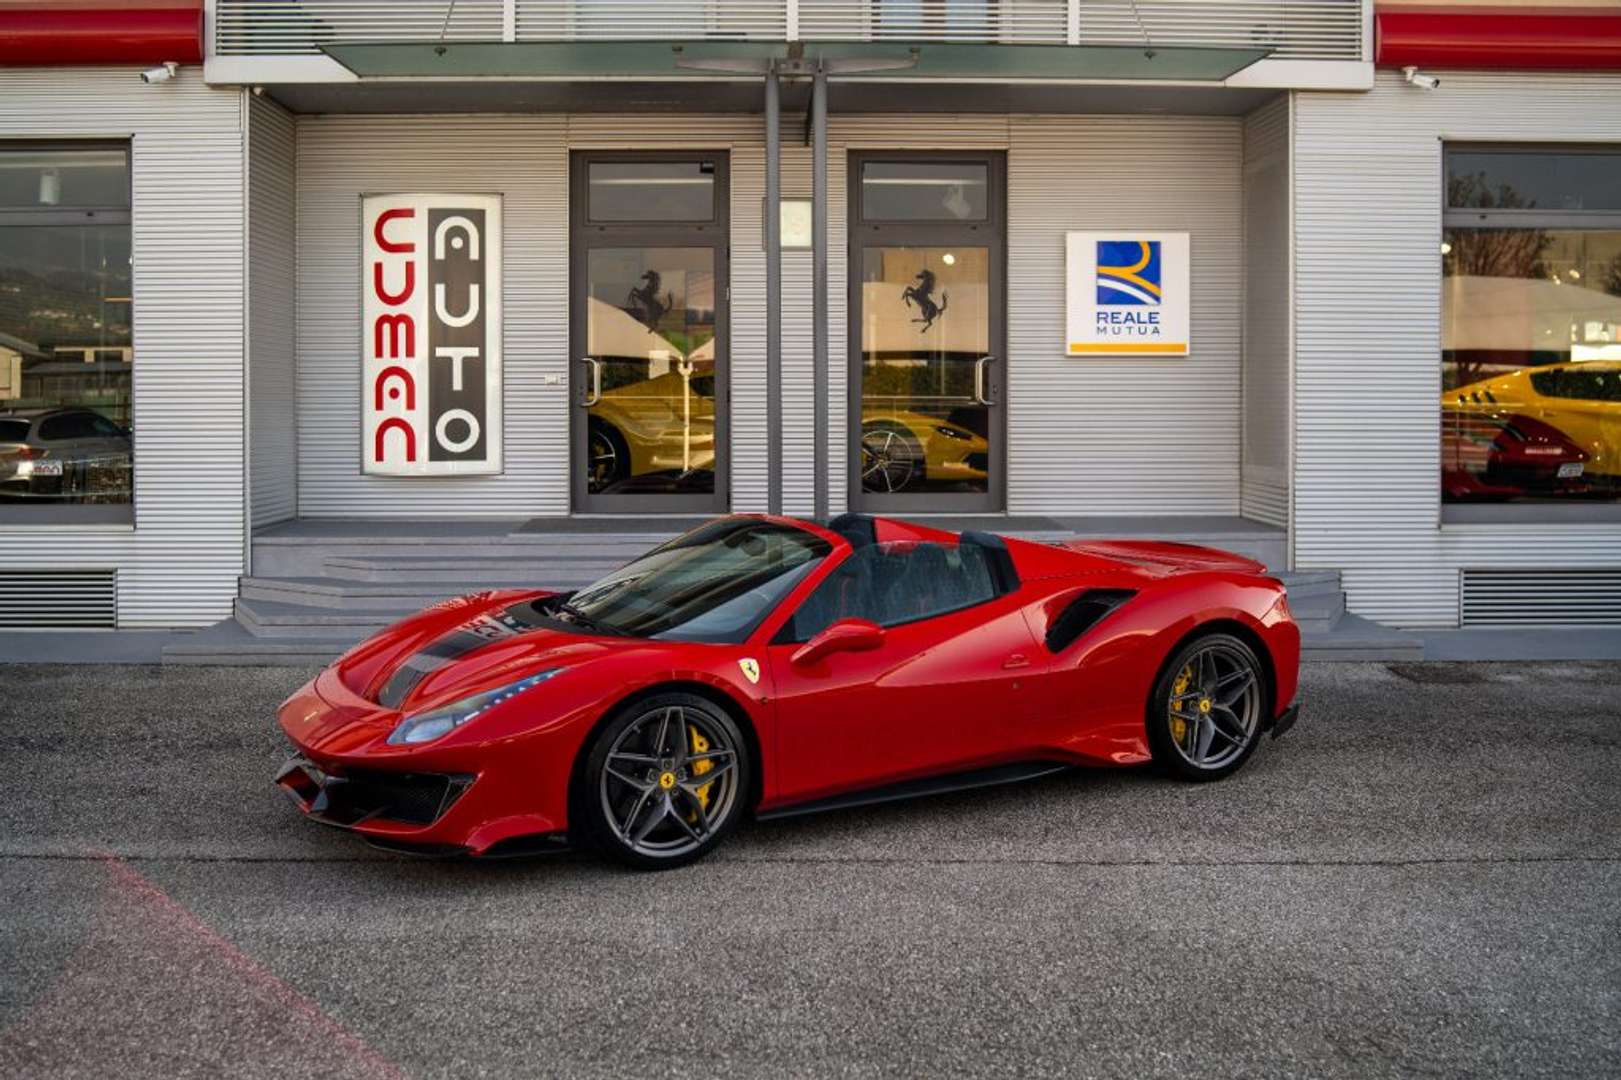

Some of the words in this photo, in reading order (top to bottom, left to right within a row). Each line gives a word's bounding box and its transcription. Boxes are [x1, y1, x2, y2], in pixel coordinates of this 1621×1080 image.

[373, 208, 416, 462] CUMAN
[435, 216, 480, 453] AUTO
[1096, 311, 1160, 324] REALE
[1096, 326, 1160, 335] MUTUA
